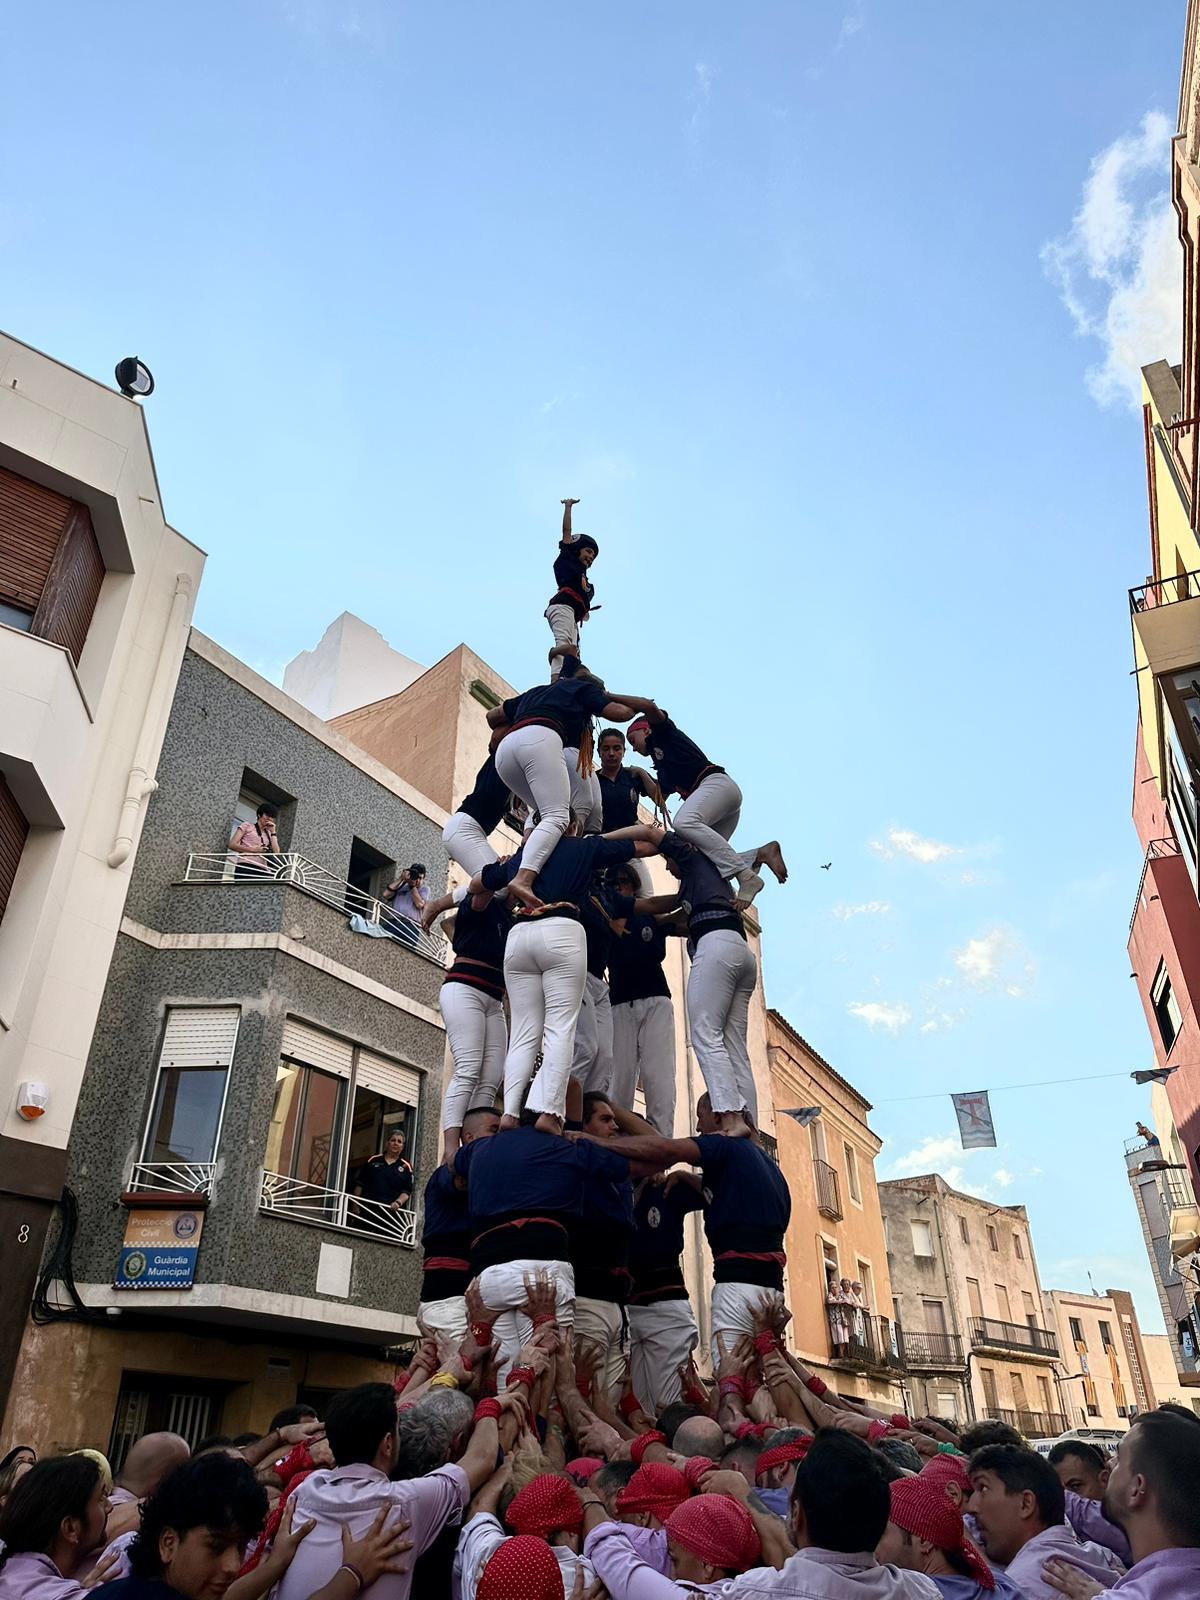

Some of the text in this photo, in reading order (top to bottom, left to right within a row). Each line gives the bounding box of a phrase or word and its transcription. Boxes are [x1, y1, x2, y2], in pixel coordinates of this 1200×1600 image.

[131, 1217, 173, 1226] Protecció
[17, 1224, 30, 1243] 8
[141, 1228, 160, 1237] Civil
[153, 1255, 188, 1264] Guàrdia
[147, 1267, 191, 1277] Municipal
